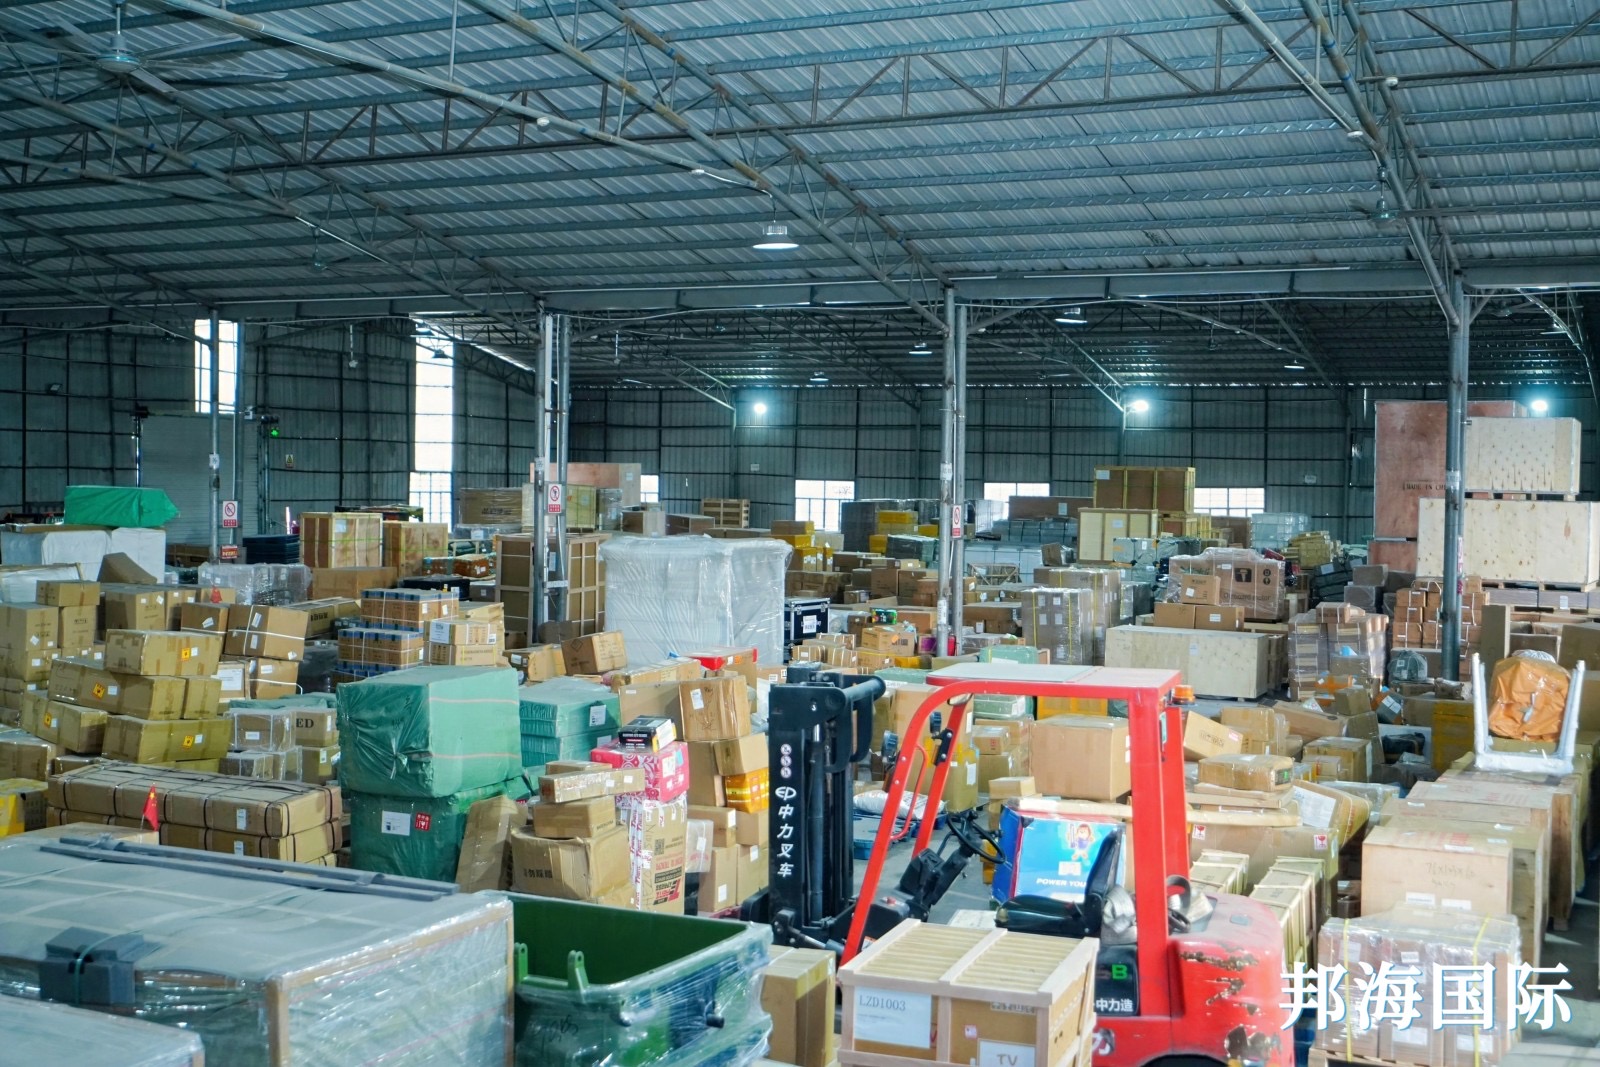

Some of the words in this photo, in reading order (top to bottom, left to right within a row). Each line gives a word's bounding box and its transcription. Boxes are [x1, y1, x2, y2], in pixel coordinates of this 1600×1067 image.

[296, 718, 314, 728] ED
[777, 803, 794, 878] 中力叉车
[1036, 877, 1067, 886] POWER
[859, 994, 906, 1012] LZD1003
[996, 1054, 1018, 1066] TV
